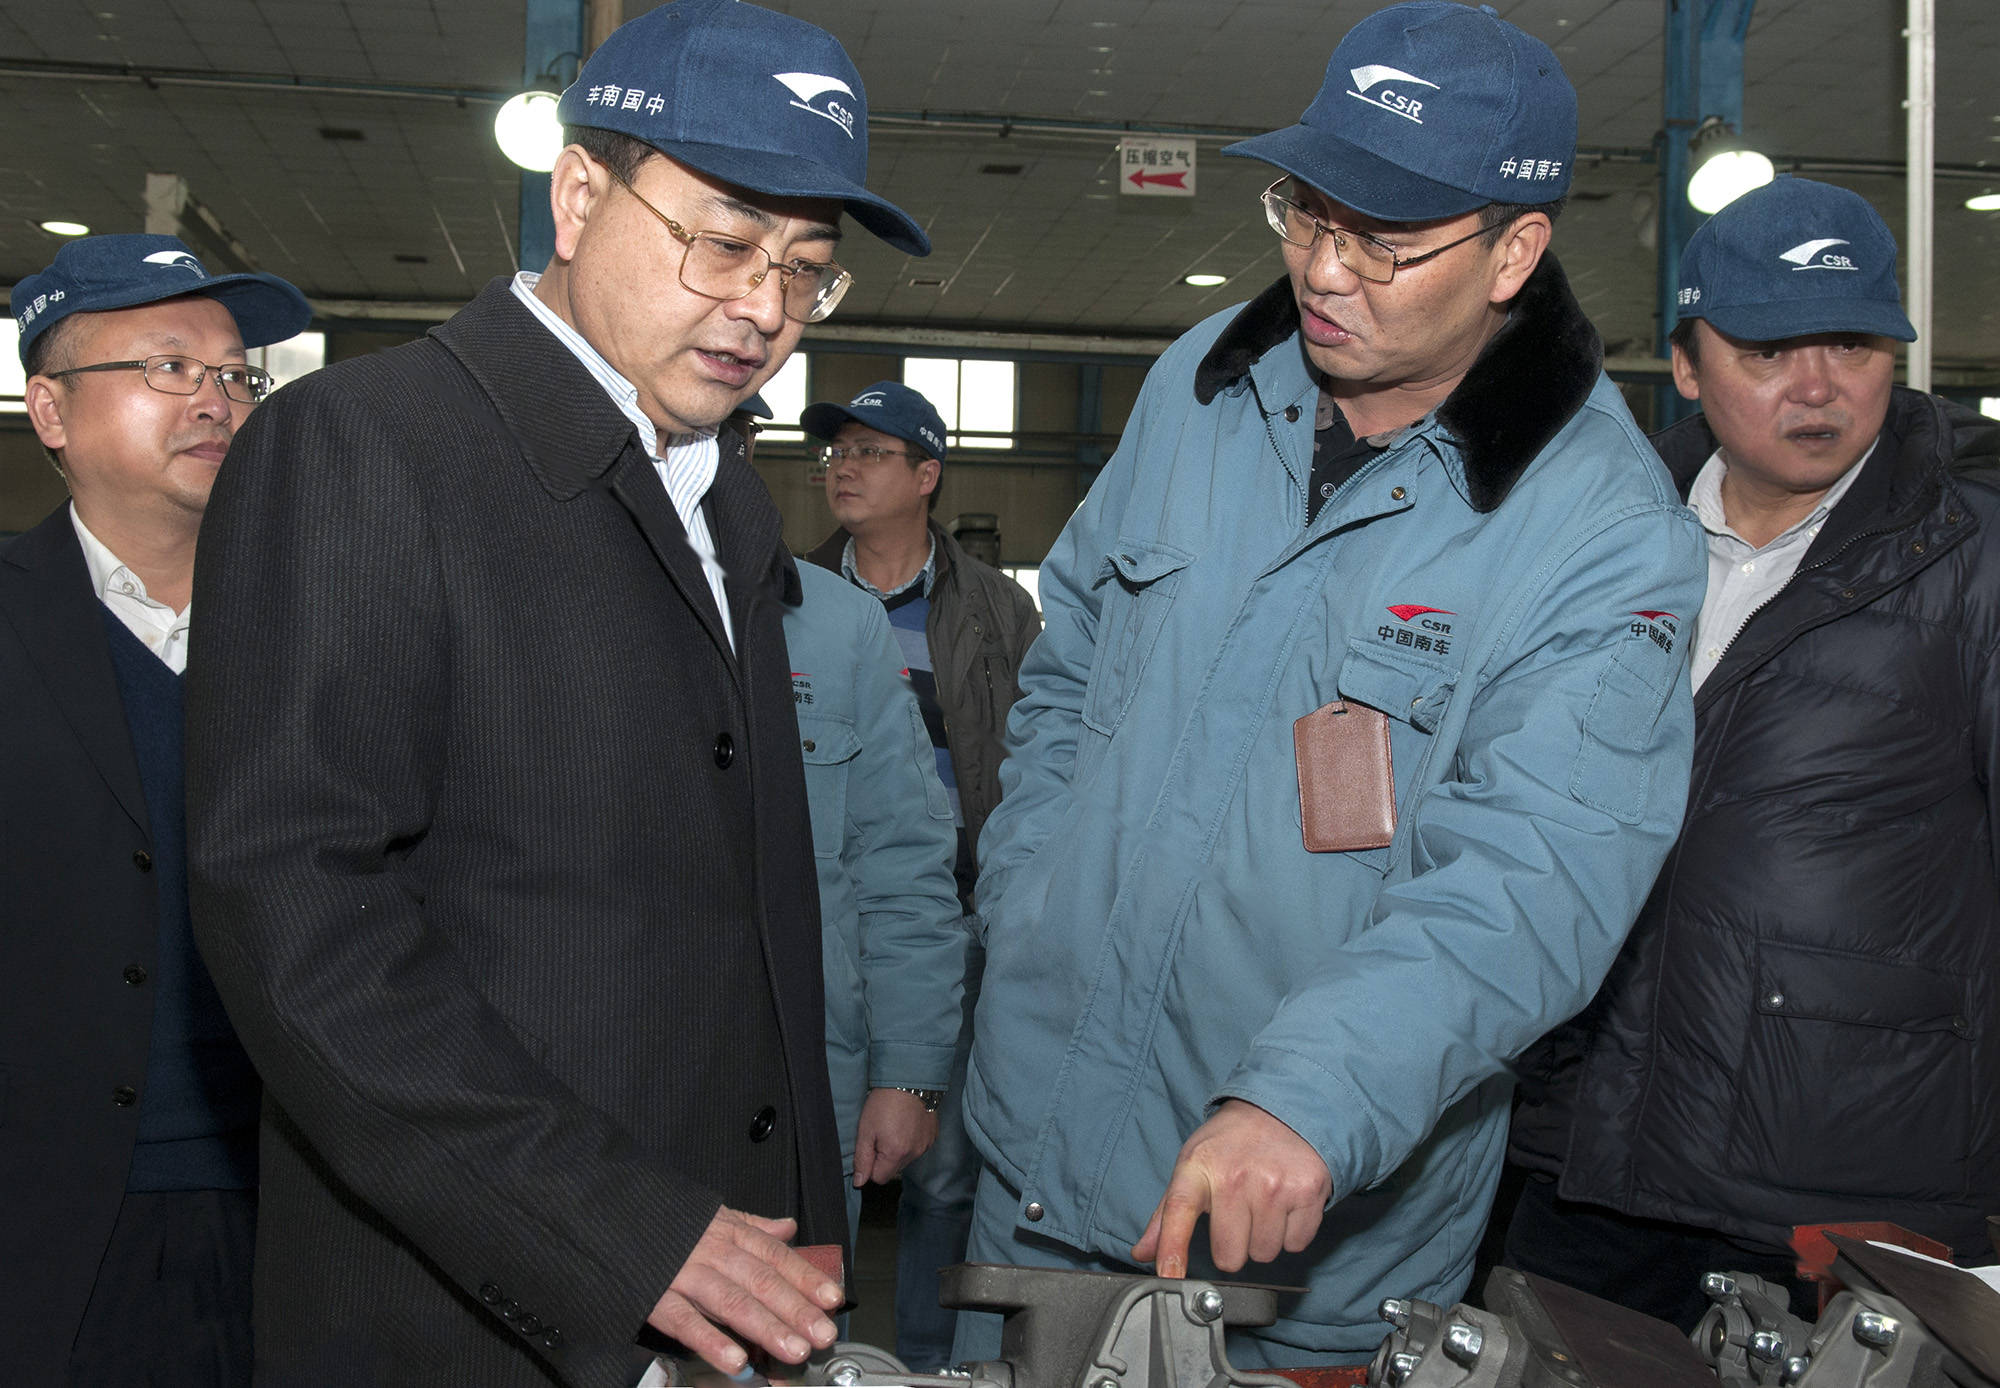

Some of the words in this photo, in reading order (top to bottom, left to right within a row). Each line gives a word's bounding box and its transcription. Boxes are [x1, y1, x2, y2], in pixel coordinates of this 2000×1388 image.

[1381, 89, 1423, 118] CSR
[827, 101, 854, 132] CSR
[1126, 148, 1191, 167] 压缩空气
[1499, 156, 1563, 181] 中国南车
[1822, 254, 1852, 267] CSR
[1421, 618, 1452, 634] CSR
[1630, 621, 1674, 655] 中国南车
[1377, 624, 1452, 656] 中国南车
[792, 680, 812, 689] CSR
